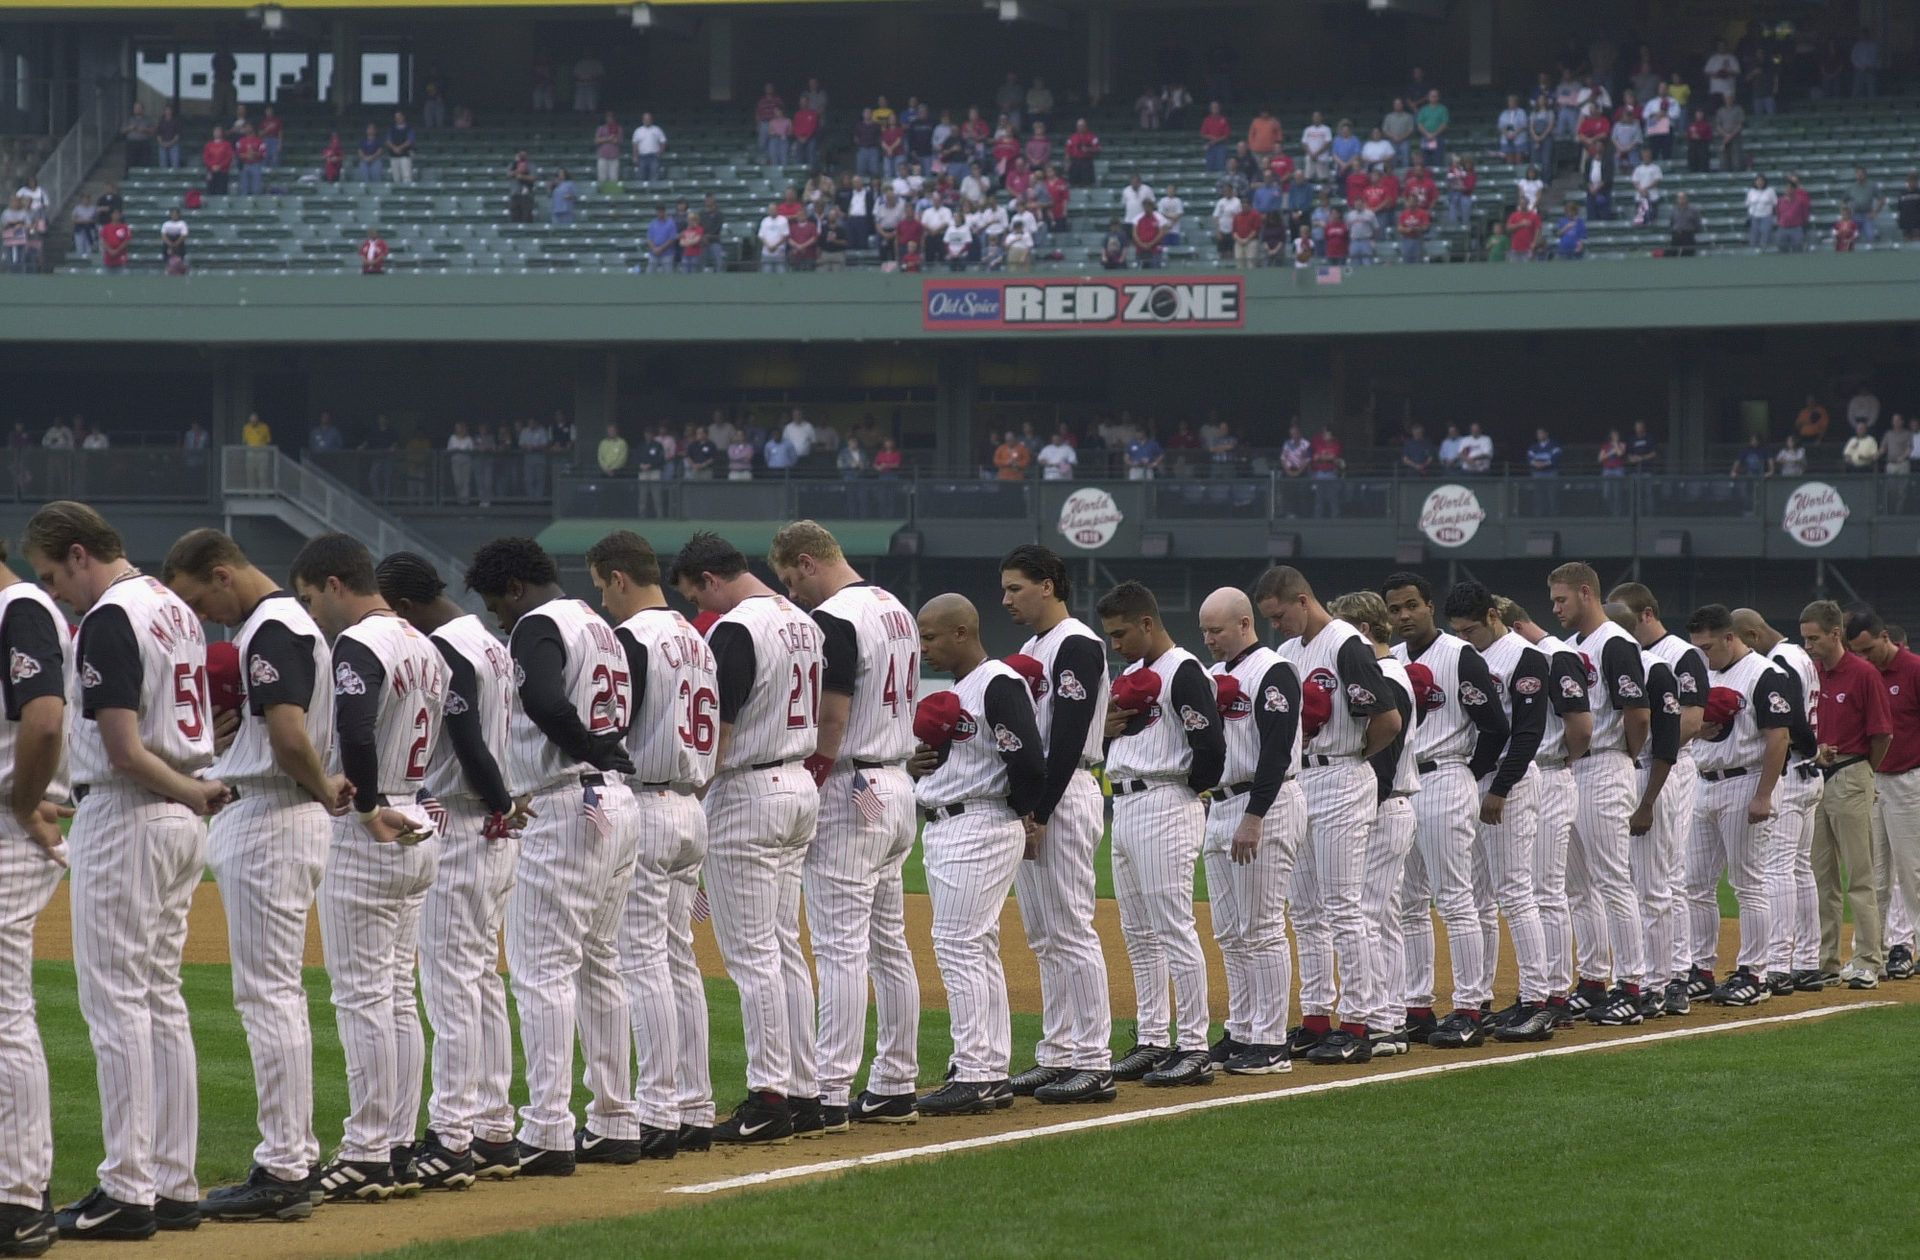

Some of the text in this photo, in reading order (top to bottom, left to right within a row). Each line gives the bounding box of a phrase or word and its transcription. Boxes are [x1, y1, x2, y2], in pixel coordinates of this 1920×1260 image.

[929, 291, 999, 318] Old Spice
[1004, 284, 1239, 323] RED ZONE
[1068, 493, 1112, 513] World
[1431, 490, 1474, 511] World
[1794, 487, 1837, 510] World
[1058, 509, 1123, 533] Champions
[1419, 508, 1486, 531] Champions
[1784, 505, 1850, 531] Champions
[786, 661, 820, 730] 21
[882, 651, 916, 719] 44
[587, 664, 629, 734] 25
[678, 679, 719, 757] 36
[404, 707, 430, 781] 2
